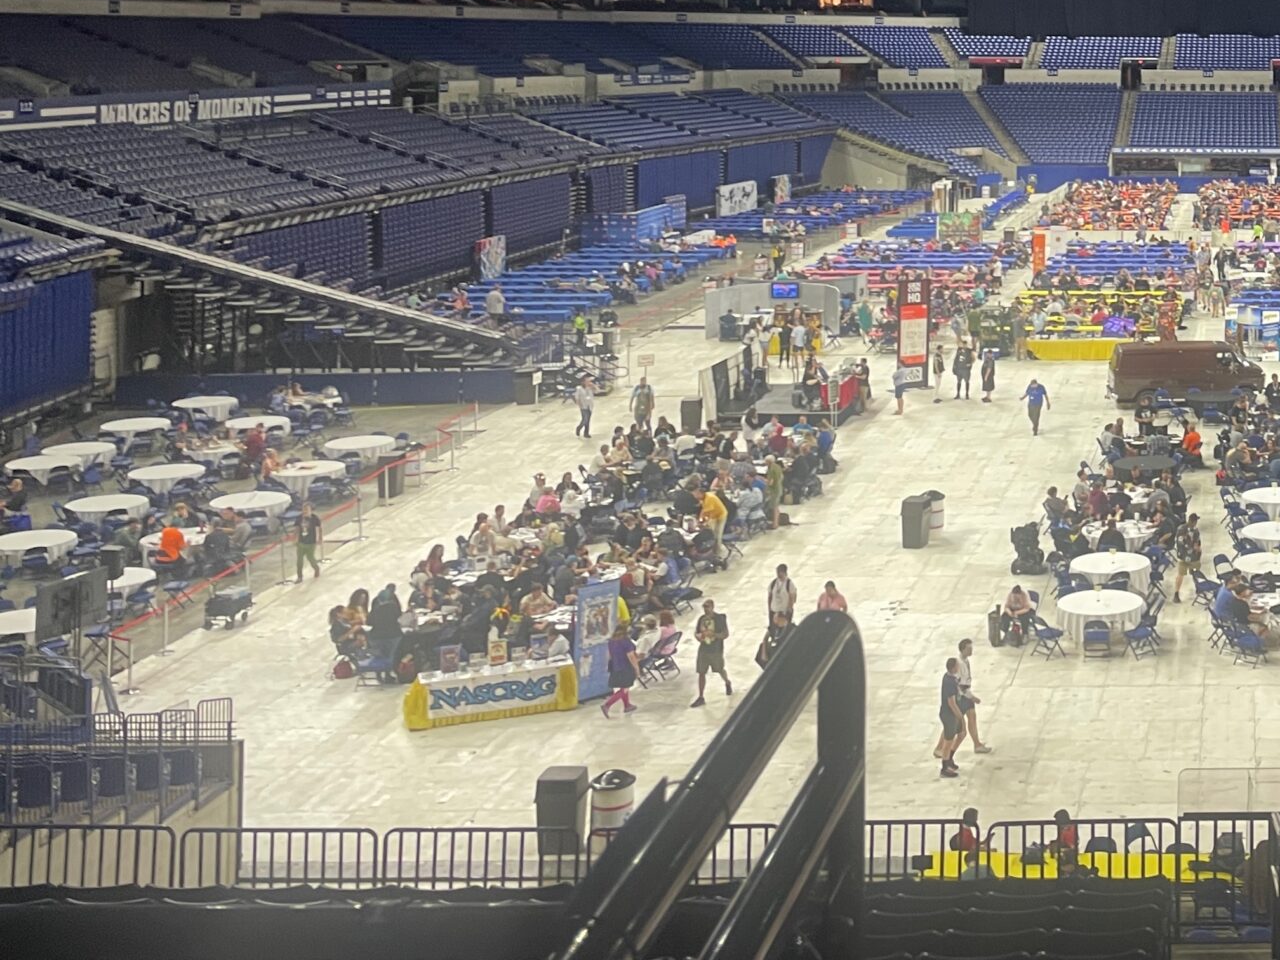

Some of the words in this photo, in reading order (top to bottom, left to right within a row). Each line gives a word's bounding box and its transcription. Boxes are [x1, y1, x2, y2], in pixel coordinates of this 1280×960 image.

[100, 100, 170, 125] MAKERS
[197, 96, 271, 120] MOMENTS
[429, 673, 557, 711] NASCRAG
